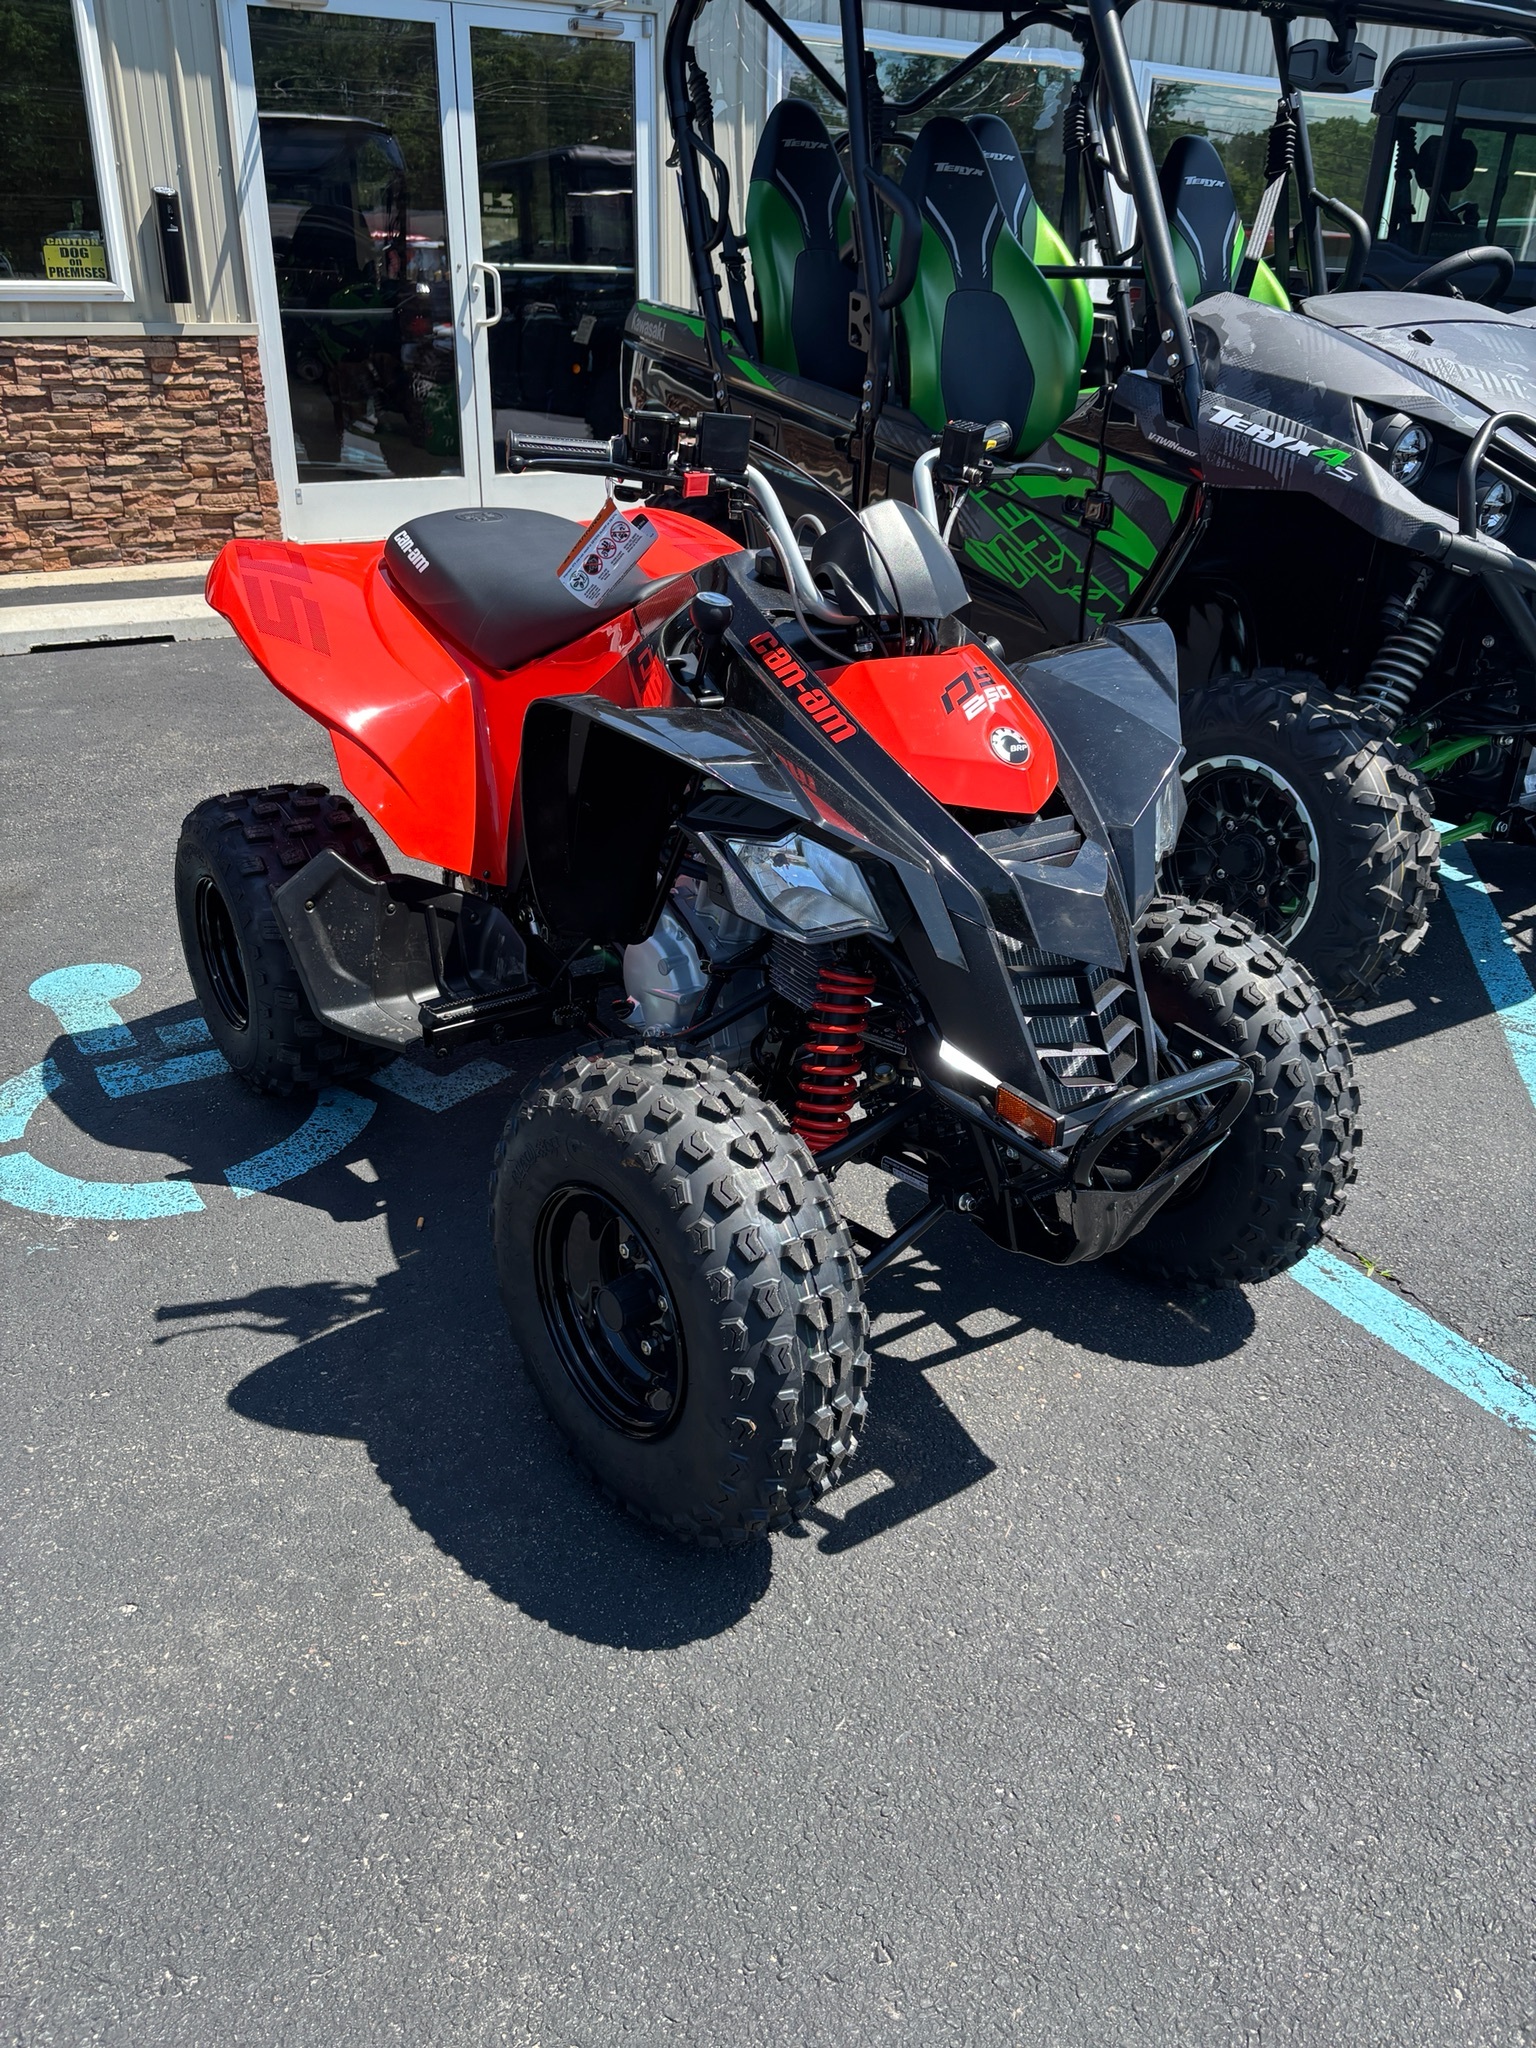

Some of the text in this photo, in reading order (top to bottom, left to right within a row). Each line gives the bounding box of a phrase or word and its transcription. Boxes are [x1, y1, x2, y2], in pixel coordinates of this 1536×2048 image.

[46, 237, 99, 246] CAUTION
[59, 247, 90, 259] DOG
[48, 266, 106, 279] PREMISES
[631, 311, 667, 342] Kawasaki
[393, 529, 431, 574] can-am
[749, 631, 858, 744] can-am
[962, 684, 1013, 722] 250
[1010, 743, 1028, 753] BRP
